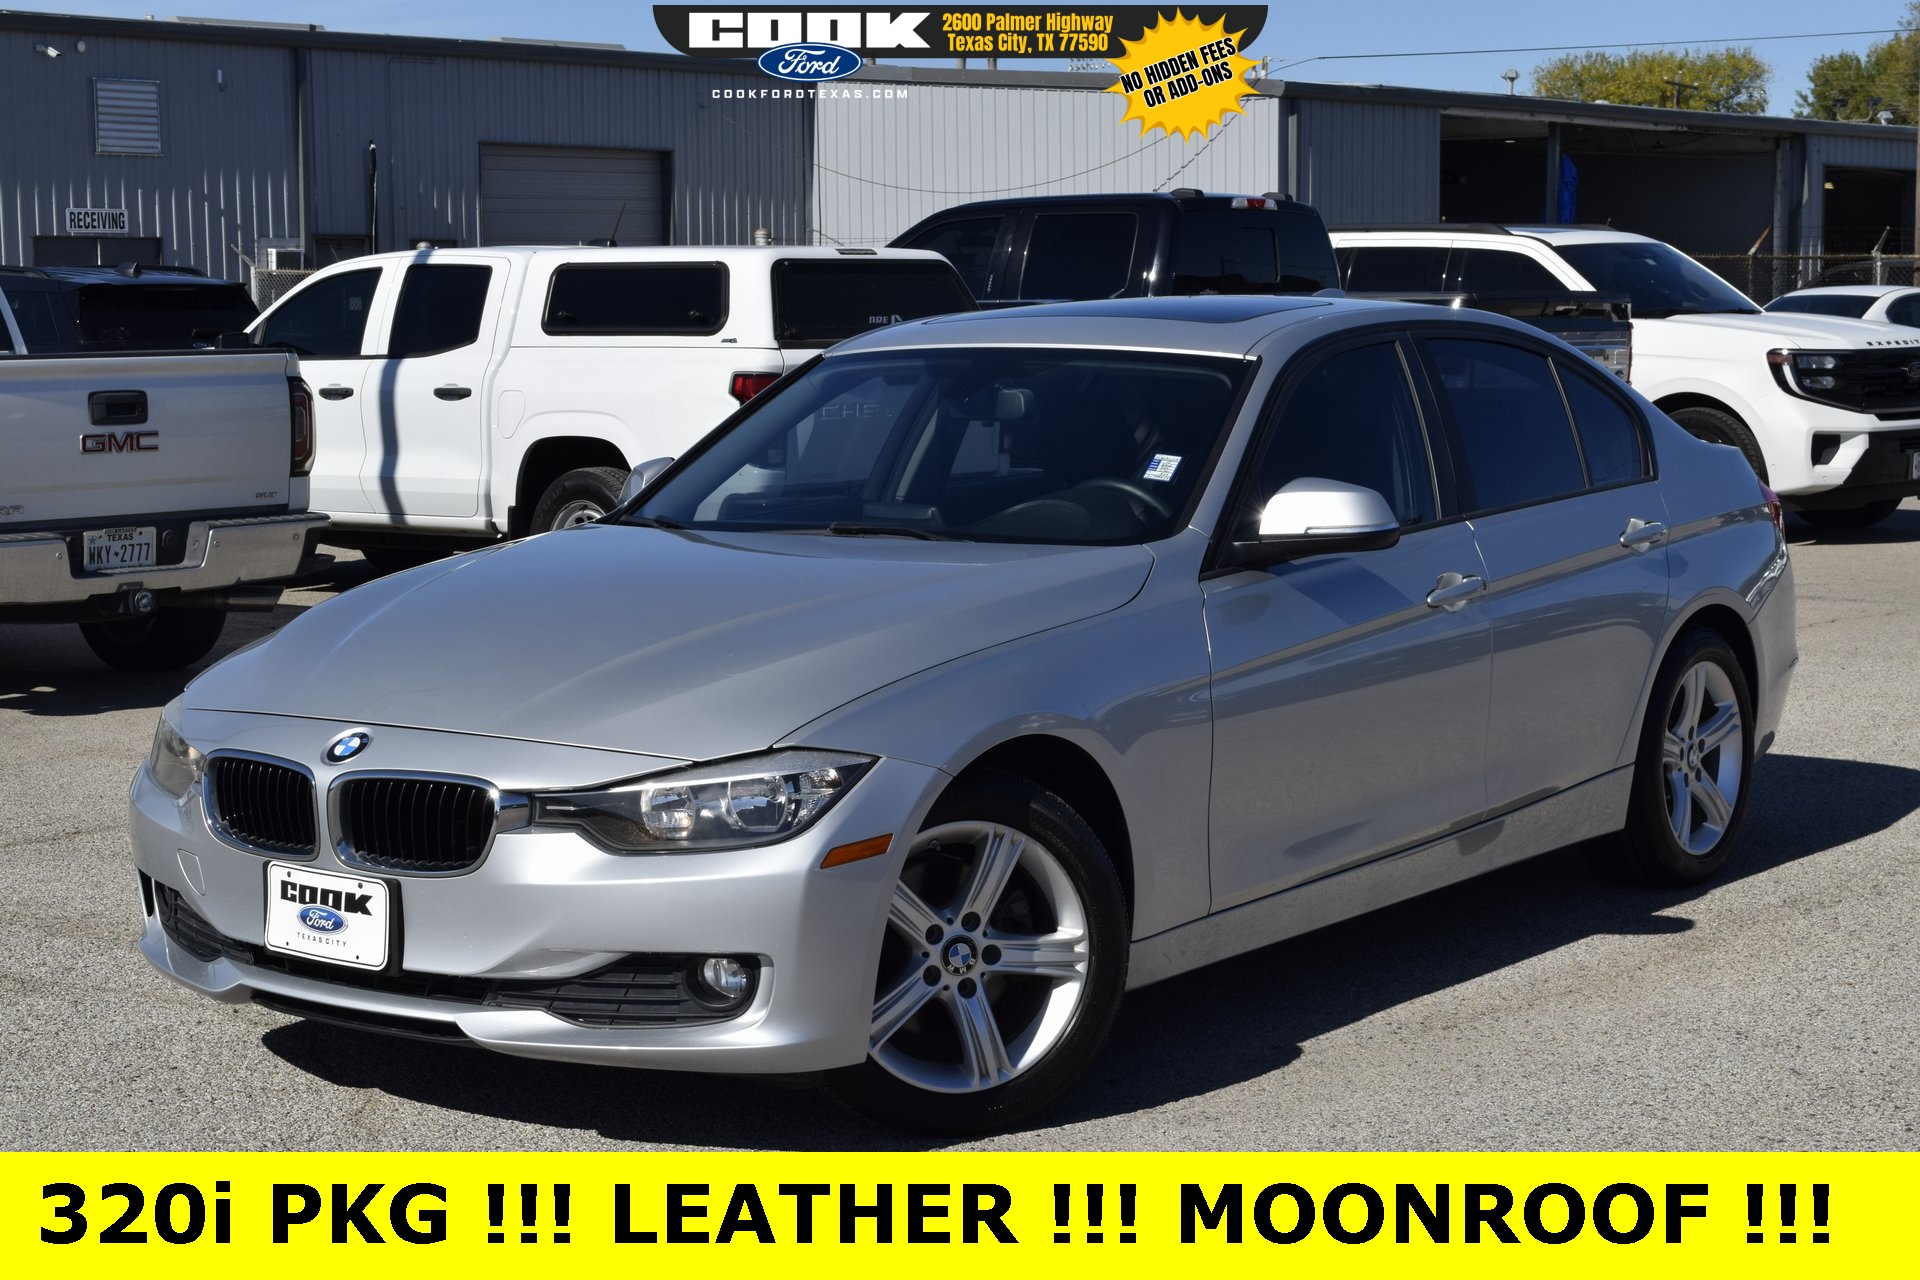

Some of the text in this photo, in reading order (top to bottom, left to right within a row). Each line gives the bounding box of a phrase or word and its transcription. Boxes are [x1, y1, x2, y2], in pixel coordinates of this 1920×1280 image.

[69, 211, 125, 230] RECEIVING
[80, 430, 160, 455] GMC
[107, 533, 134, 542] TEXAS
[120, 542, 151, 563] 2777
[280, 879, 374, 917] COOK
[306, 908, 336, 931] Ford
